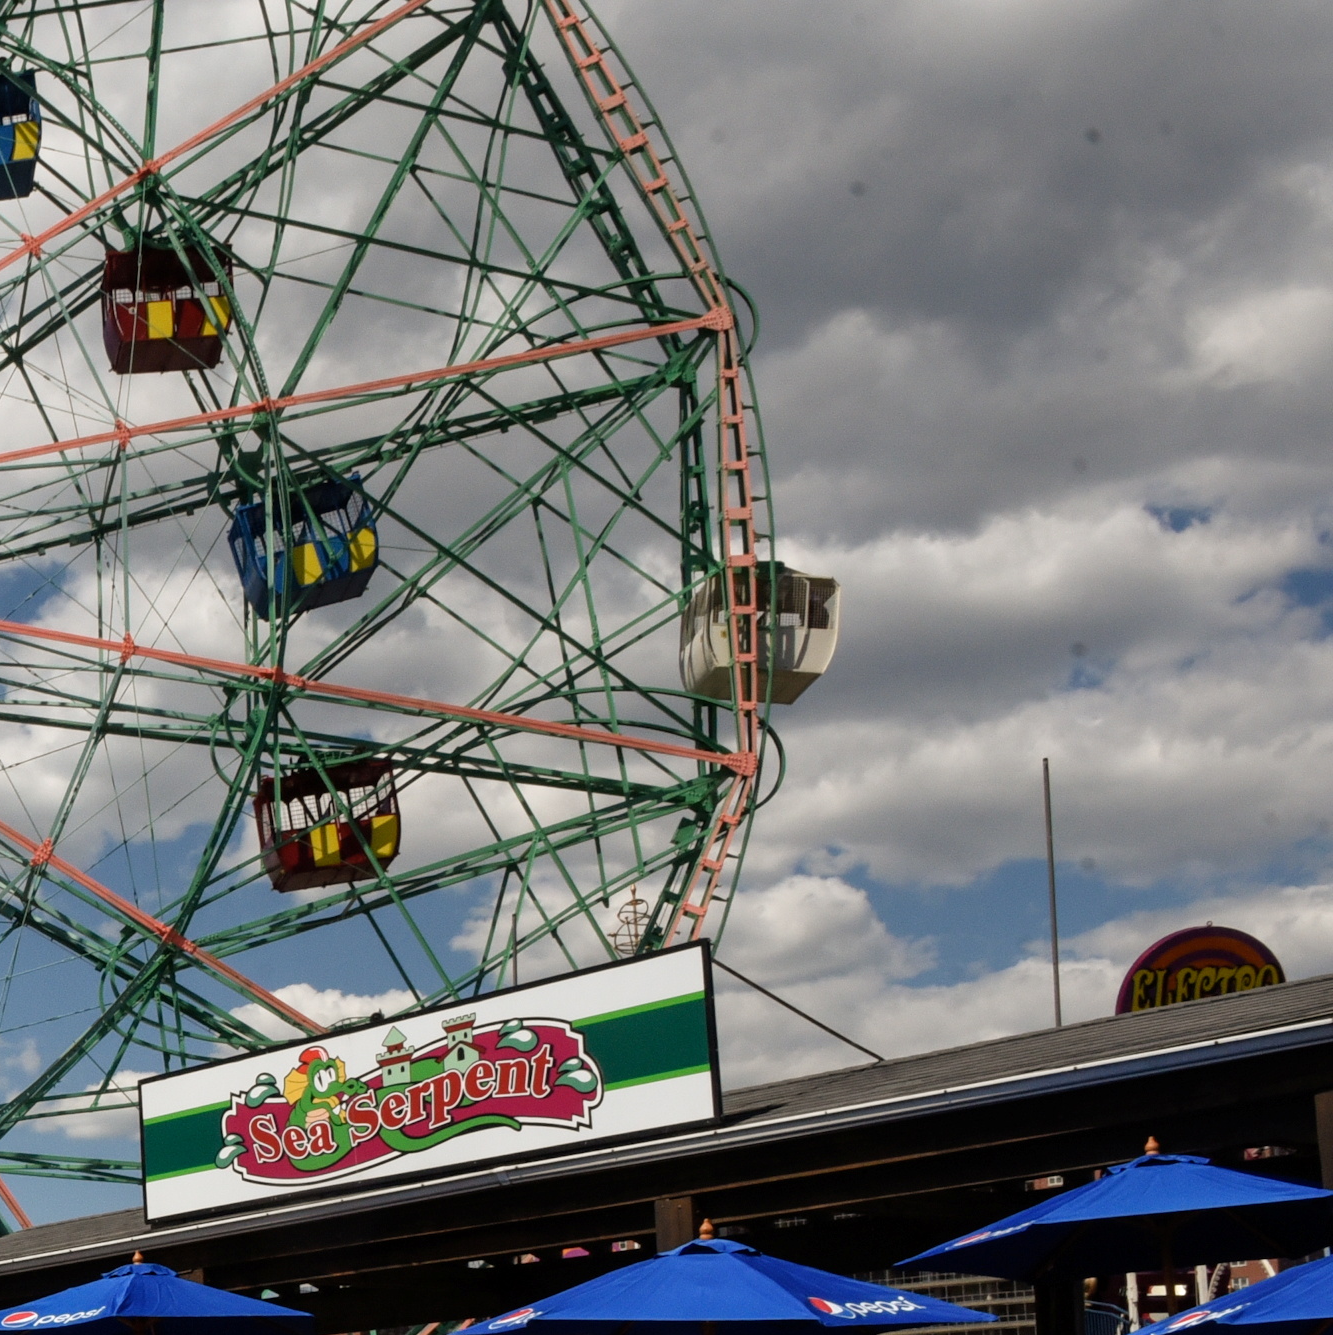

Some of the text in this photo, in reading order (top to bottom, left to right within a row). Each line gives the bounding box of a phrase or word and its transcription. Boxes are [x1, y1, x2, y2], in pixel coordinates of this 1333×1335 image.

[248, 1044, 553, 1164] Sea Serpent
[34, 1306, 107, 1327] pepsi
[845, 1296, 927, 1317] pepsi
